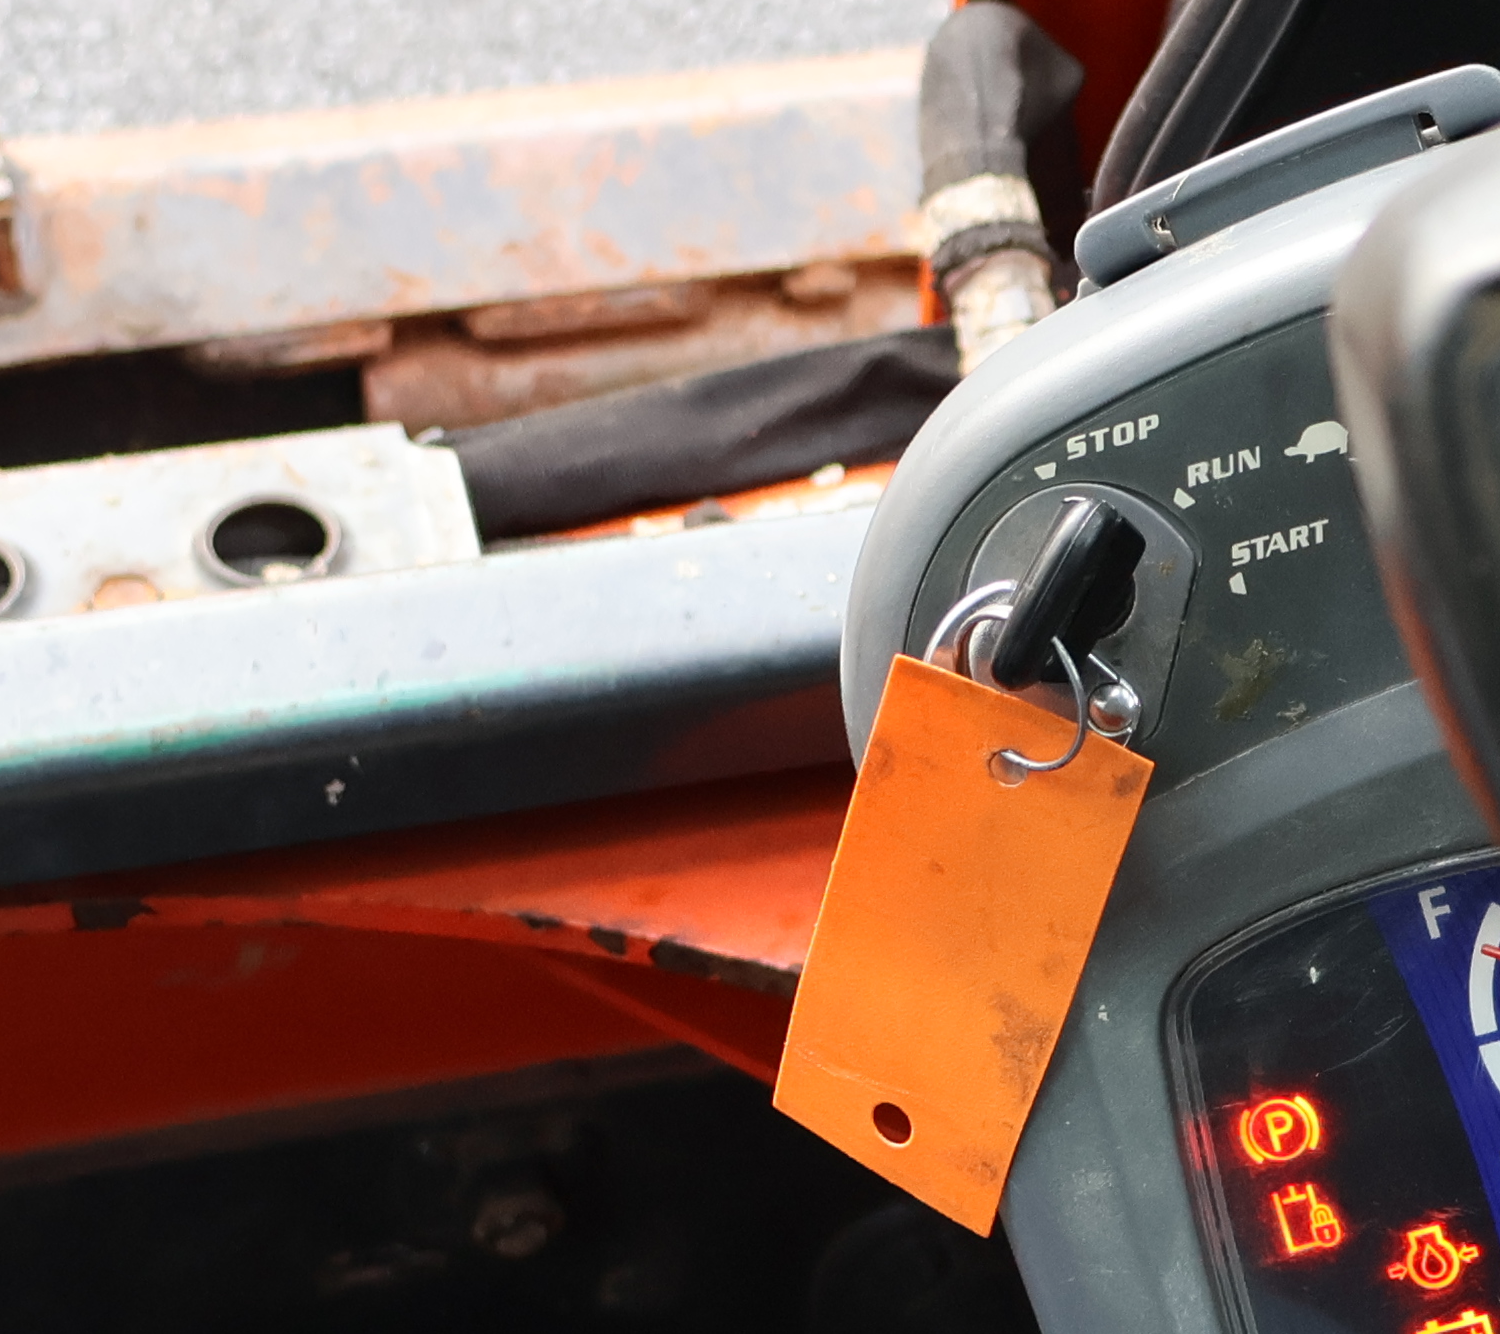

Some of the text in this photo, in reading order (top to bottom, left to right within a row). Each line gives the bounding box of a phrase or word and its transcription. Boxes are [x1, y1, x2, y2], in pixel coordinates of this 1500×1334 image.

[1066, 413, 1160, 461] STOP
[1187, 446, 1261, 488] RUN
[1231, 518, 1329, 567] START
[1417, 885, 1451, 940] F
[1264, 1109, 1294, 1153] P
